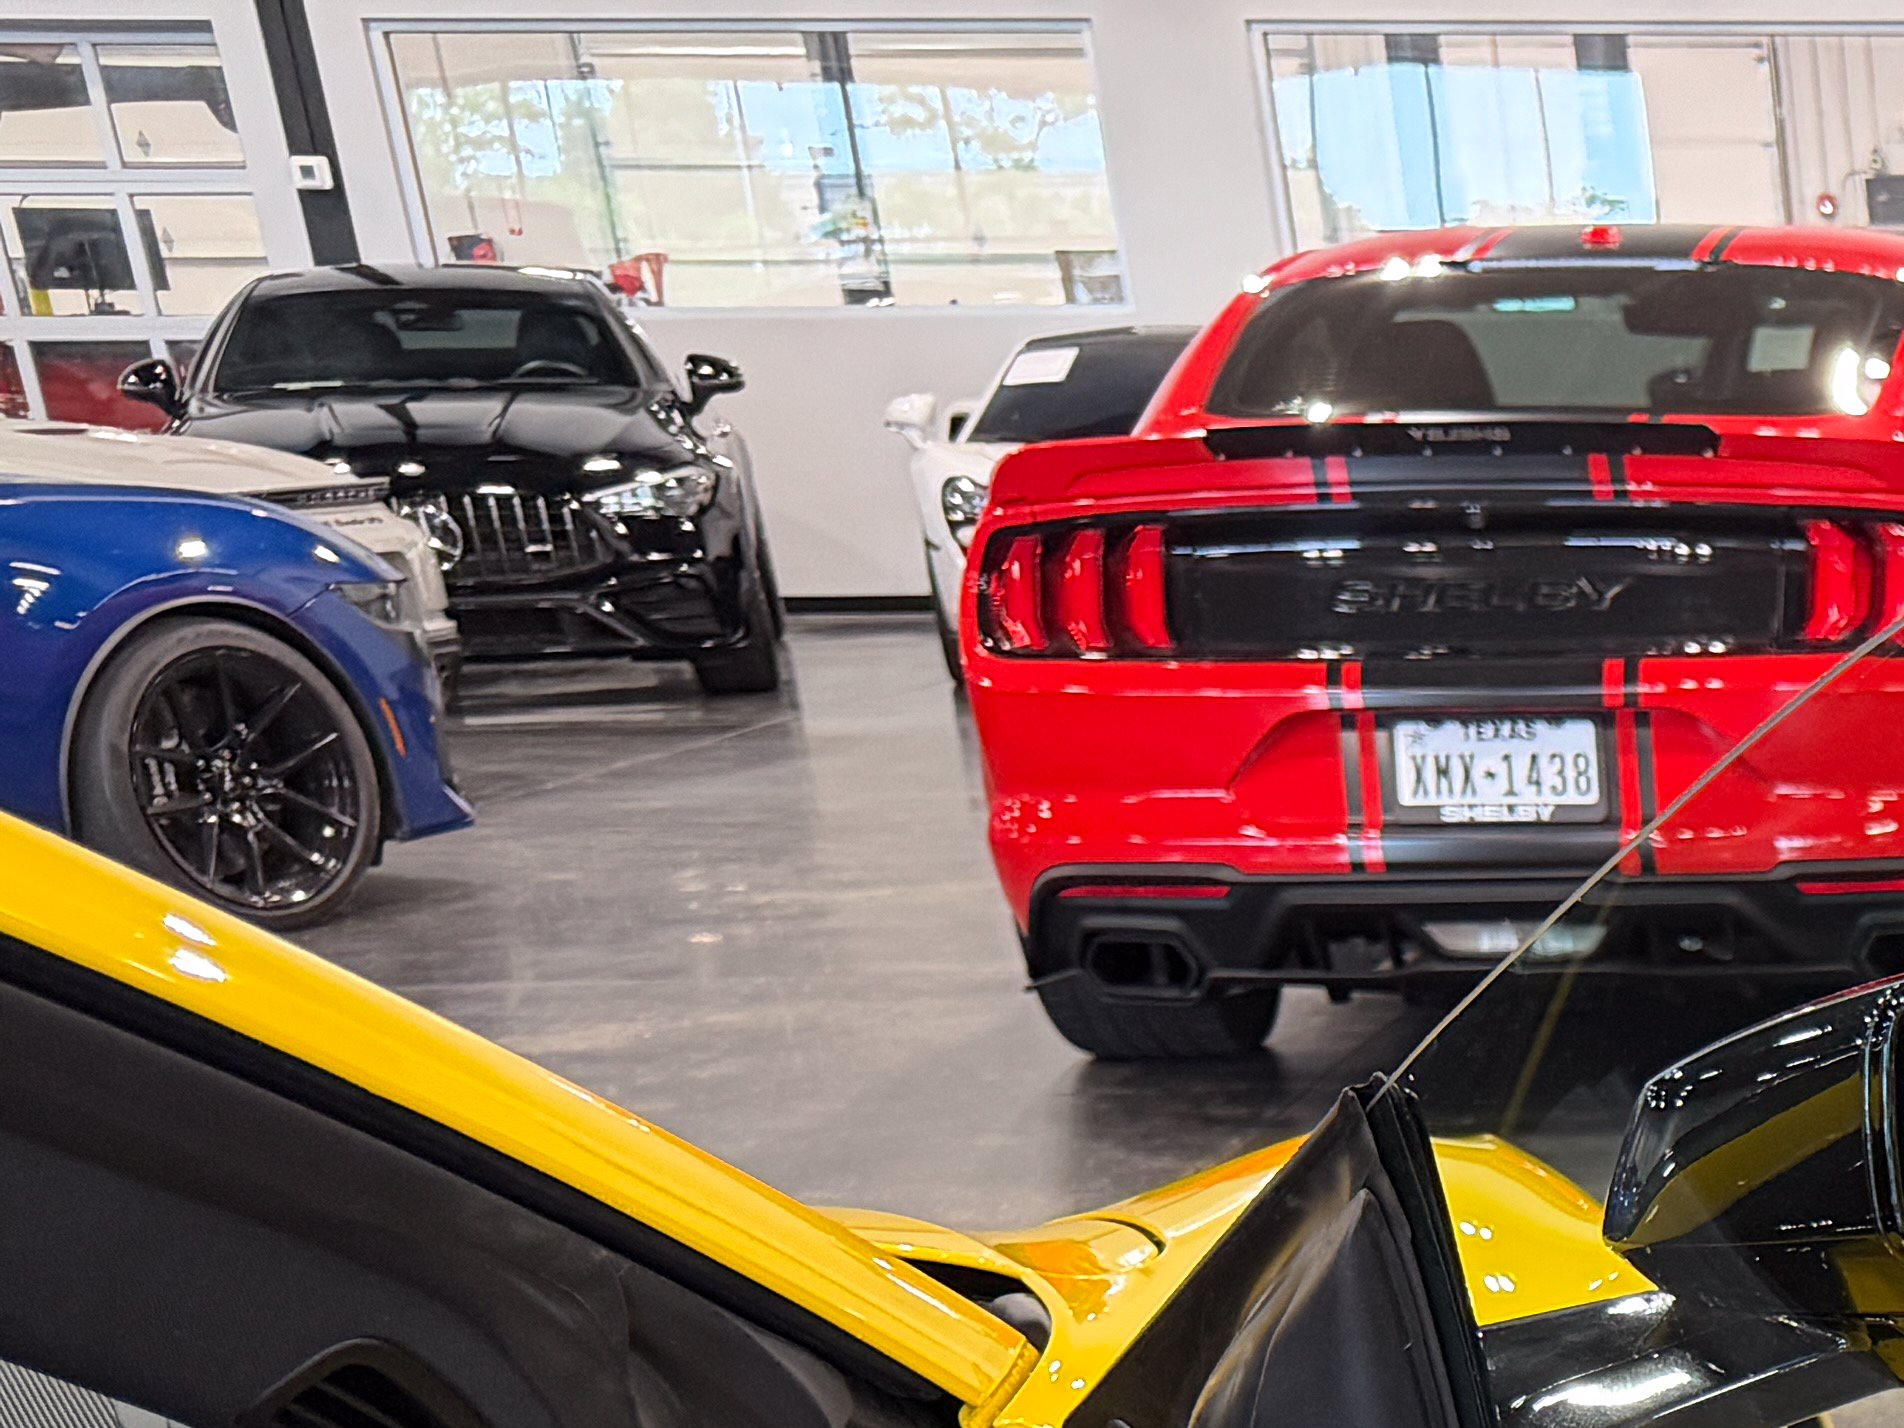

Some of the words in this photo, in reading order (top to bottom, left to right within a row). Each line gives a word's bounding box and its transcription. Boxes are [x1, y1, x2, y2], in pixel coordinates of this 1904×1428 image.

[1331, 576, 1634, 614] SHELBY
[1459, 719, 1538, 742] TEXAS
[1439, 803, 1557, 822] SHELBY
